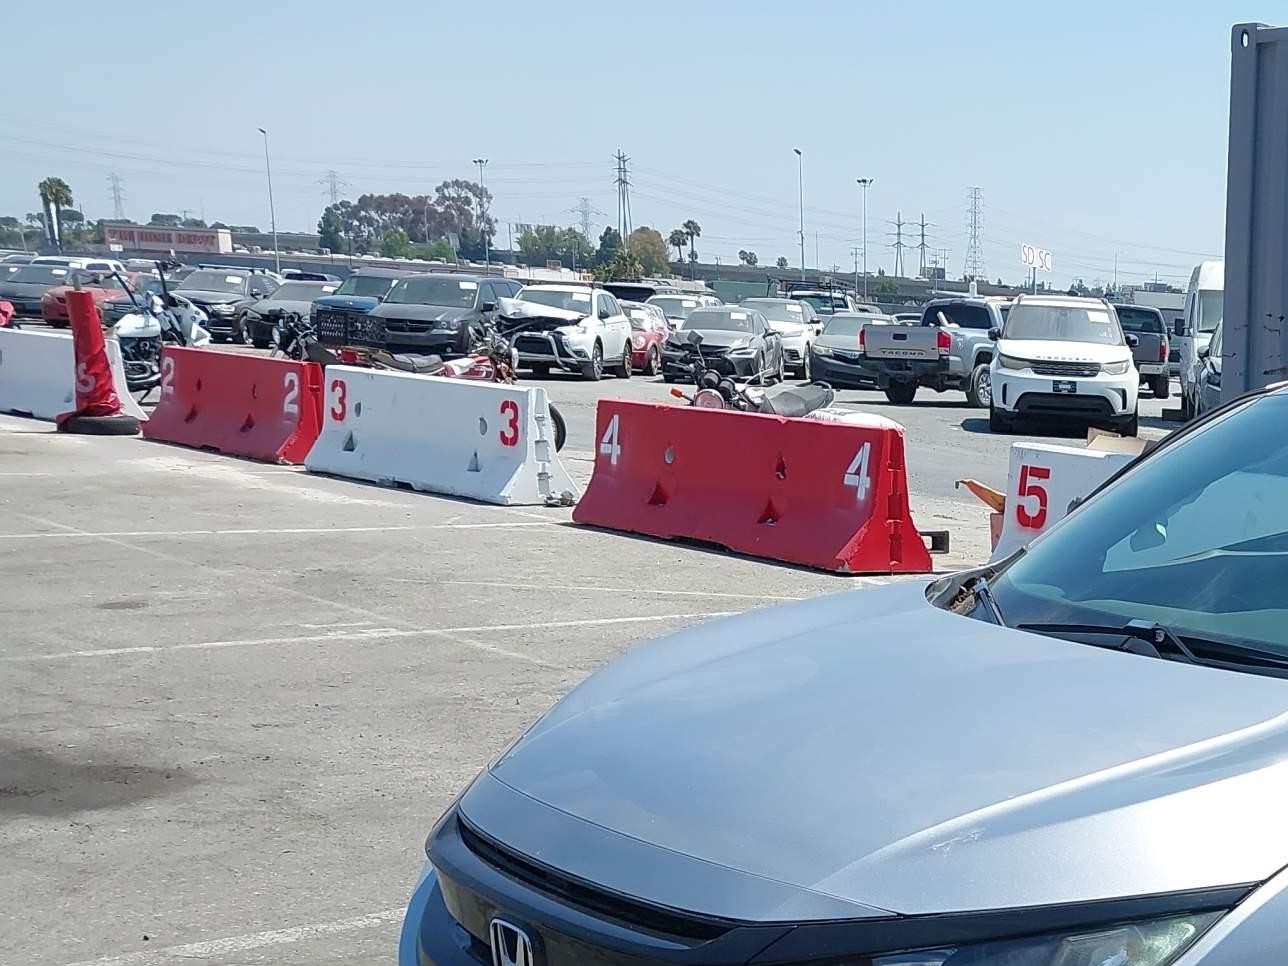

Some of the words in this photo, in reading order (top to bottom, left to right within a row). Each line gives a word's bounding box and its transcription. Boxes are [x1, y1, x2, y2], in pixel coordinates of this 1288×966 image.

[162, 356, 175, 394] 2
[283, 372, 299, 413] 2
[330, 379, 347, 421] 3
[499, 399, 519, 447] 3
[601, 413, 621, 465] 4
[843, 441, 872, 501] 4
[1017, 463, 1050, 529] 5
